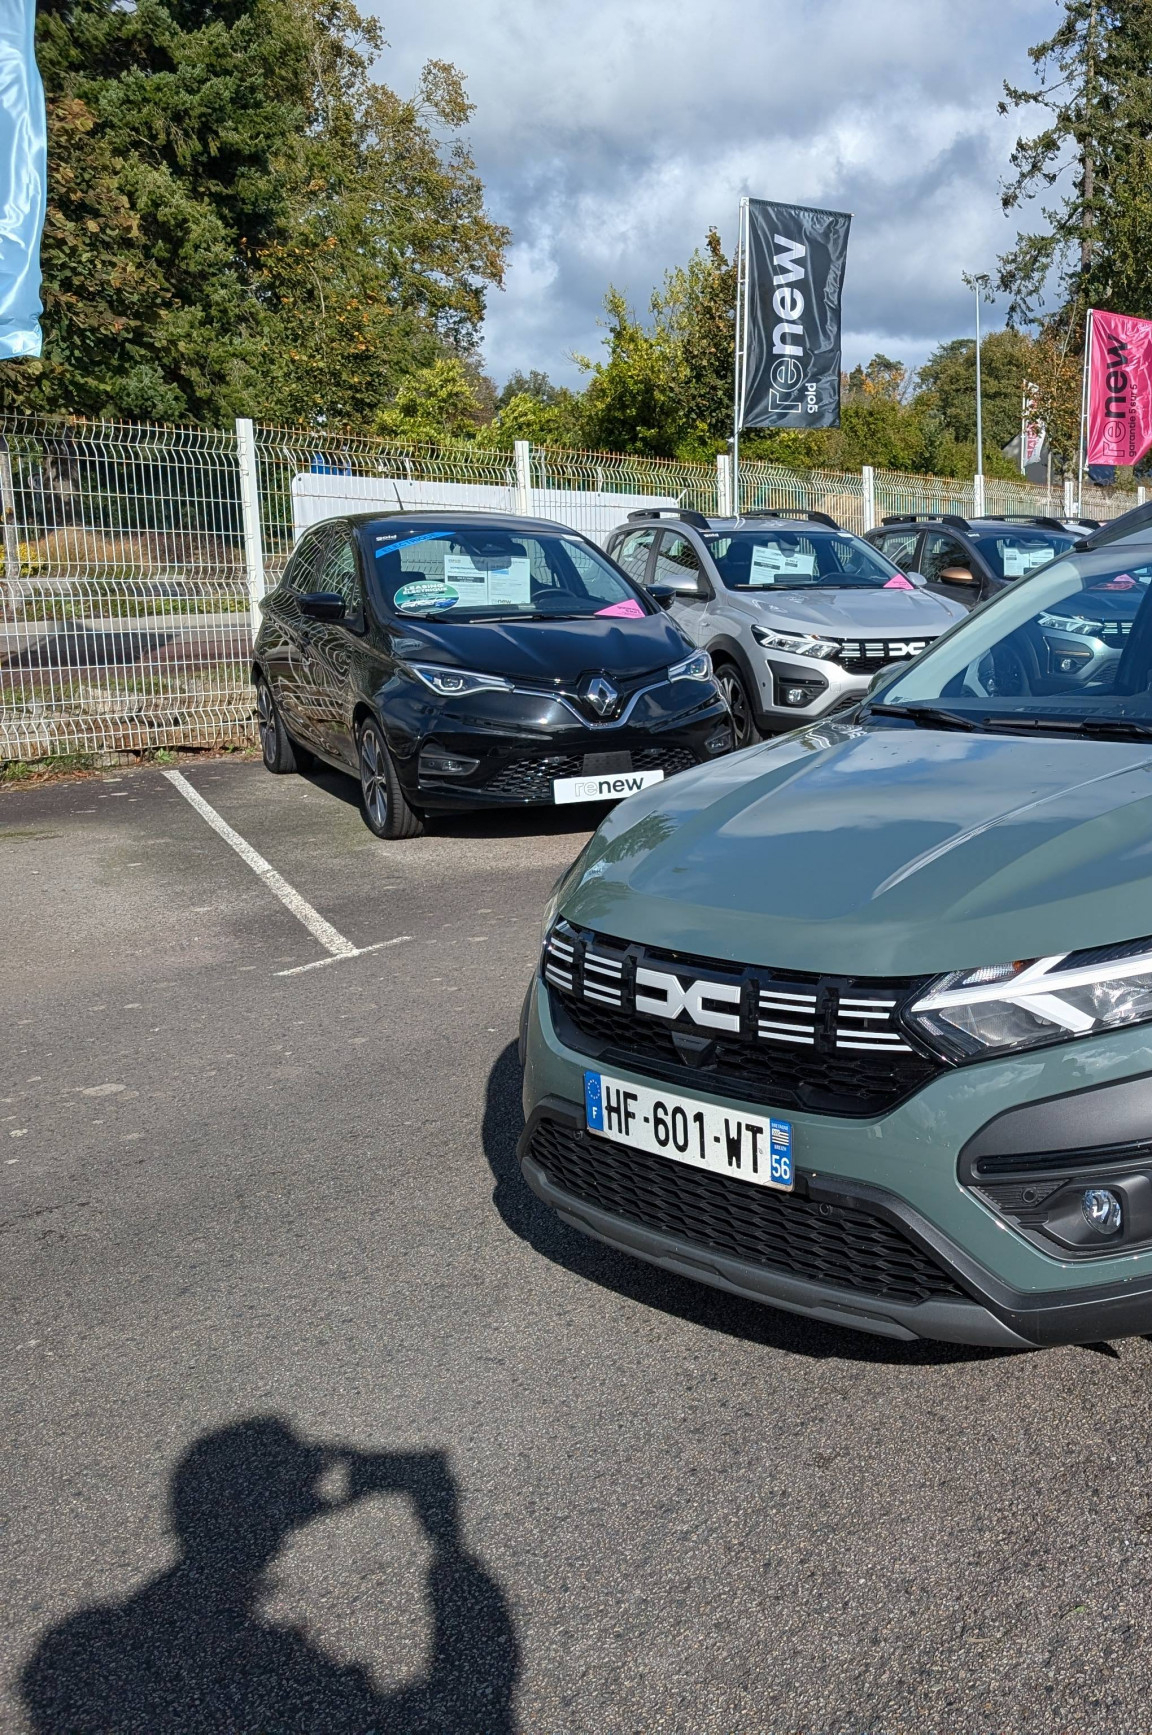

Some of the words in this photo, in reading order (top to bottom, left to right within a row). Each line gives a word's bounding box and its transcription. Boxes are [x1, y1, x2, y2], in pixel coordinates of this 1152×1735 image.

[769, 233, 806, 413] renew
[805, 382, 817, 414] gold
[1102, 333, 1128, 458] renew
[1128, 416, 1137, 457] garantie
[575, 777, 644, 797] renew
[592, 1106, 598, 1119] F
[605, 1085, 764, 1174] HF-601-WT
[771, 1154, 790, 1180] 56
